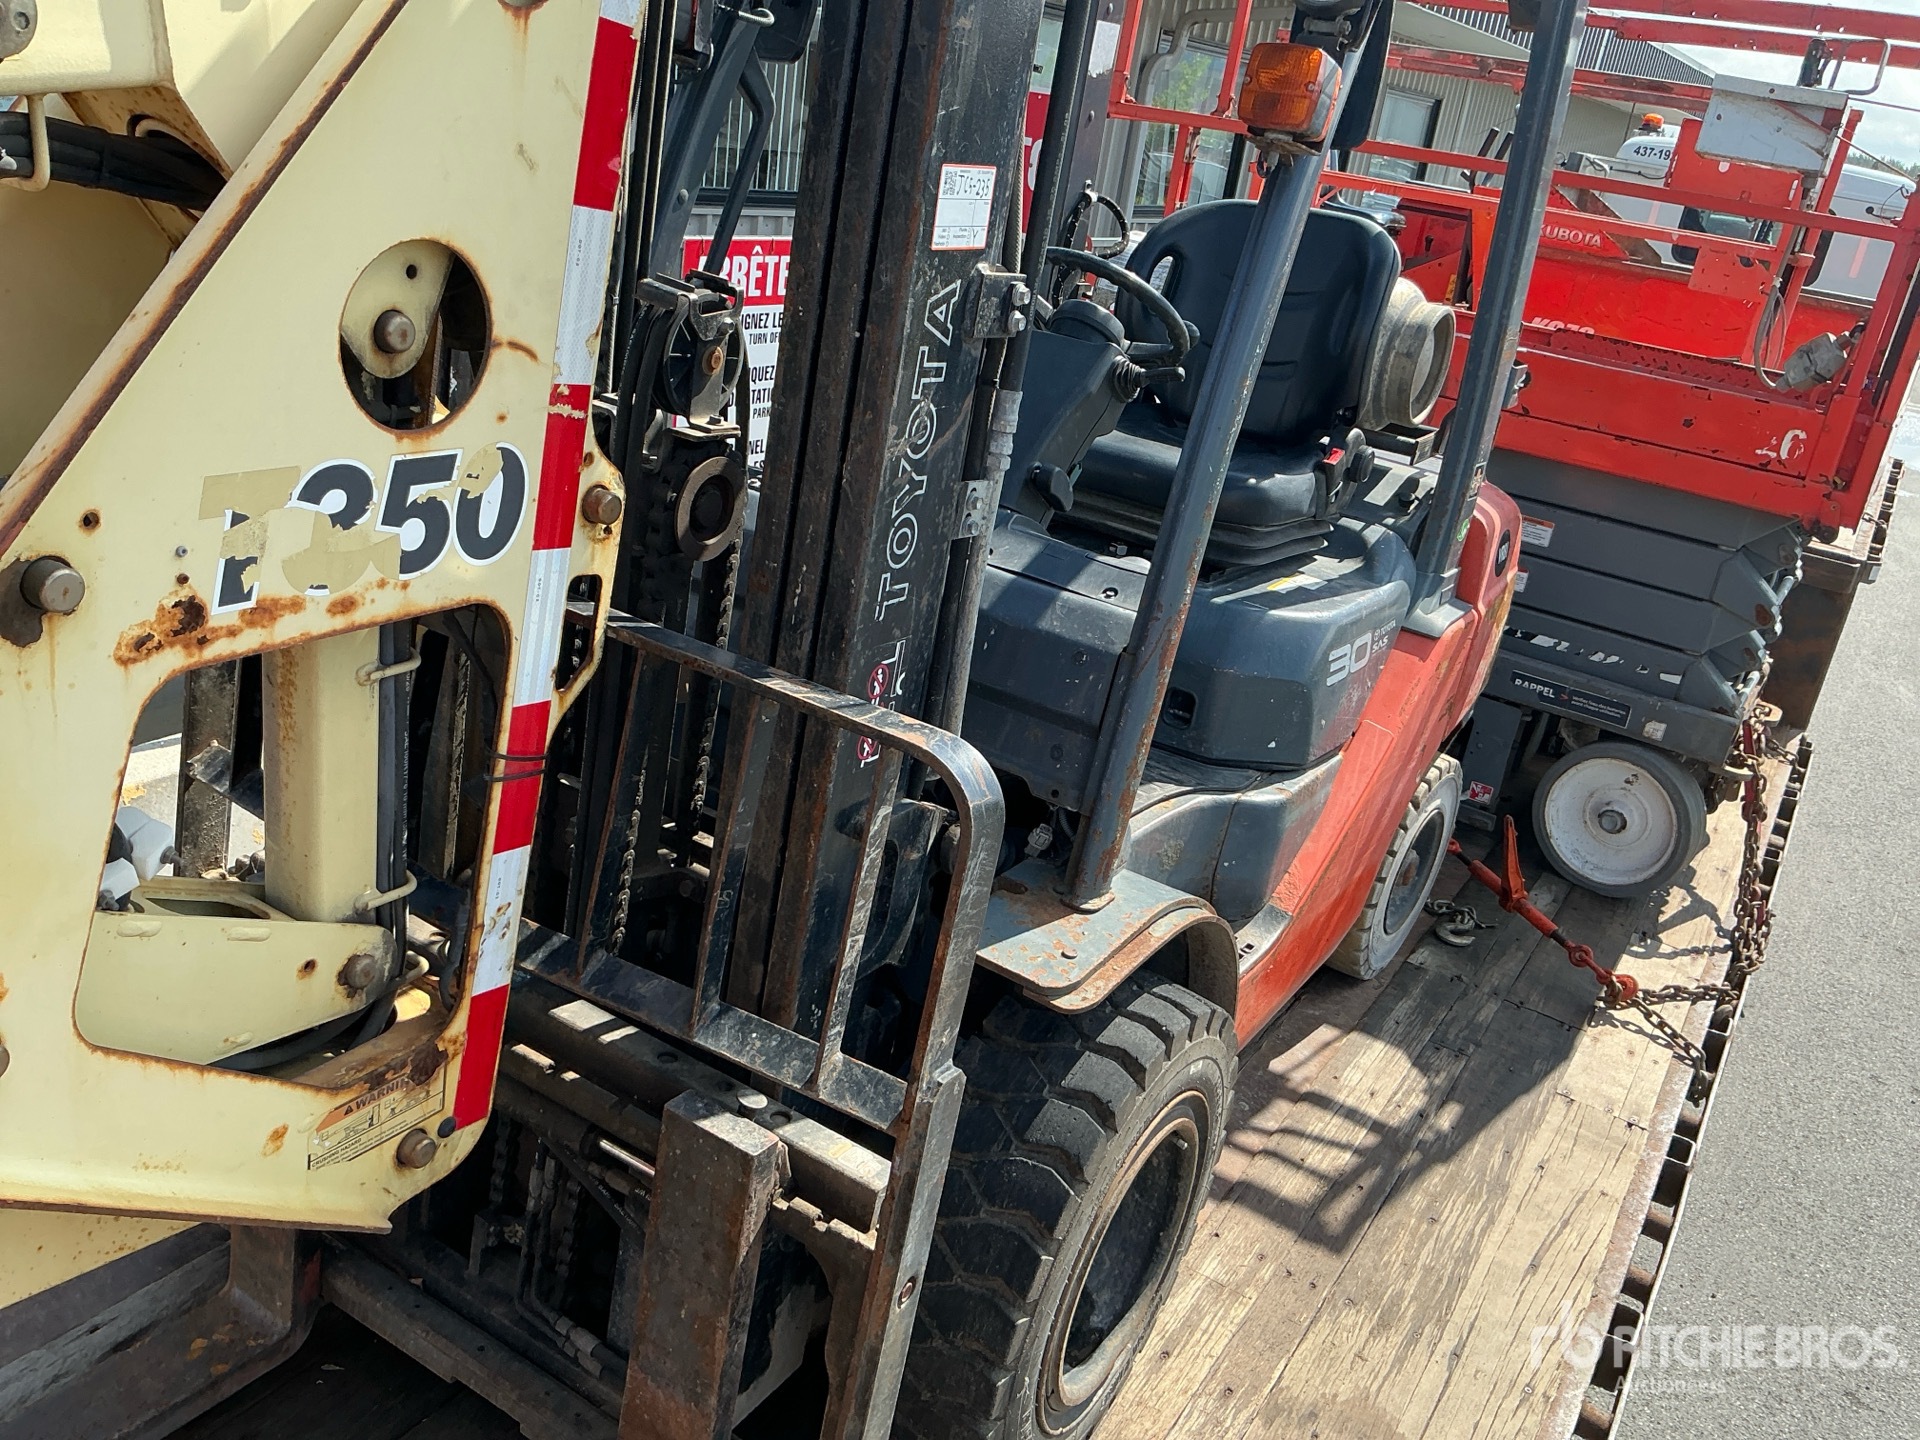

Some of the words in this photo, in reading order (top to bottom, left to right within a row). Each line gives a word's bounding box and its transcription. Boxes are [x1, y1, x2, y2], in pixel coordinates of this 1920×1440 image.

[874, 278, 962, 622] TOYOTA
[1326, 632, 1373, 687] 30
[1513, 678, 1556, 699] RAPPEL
